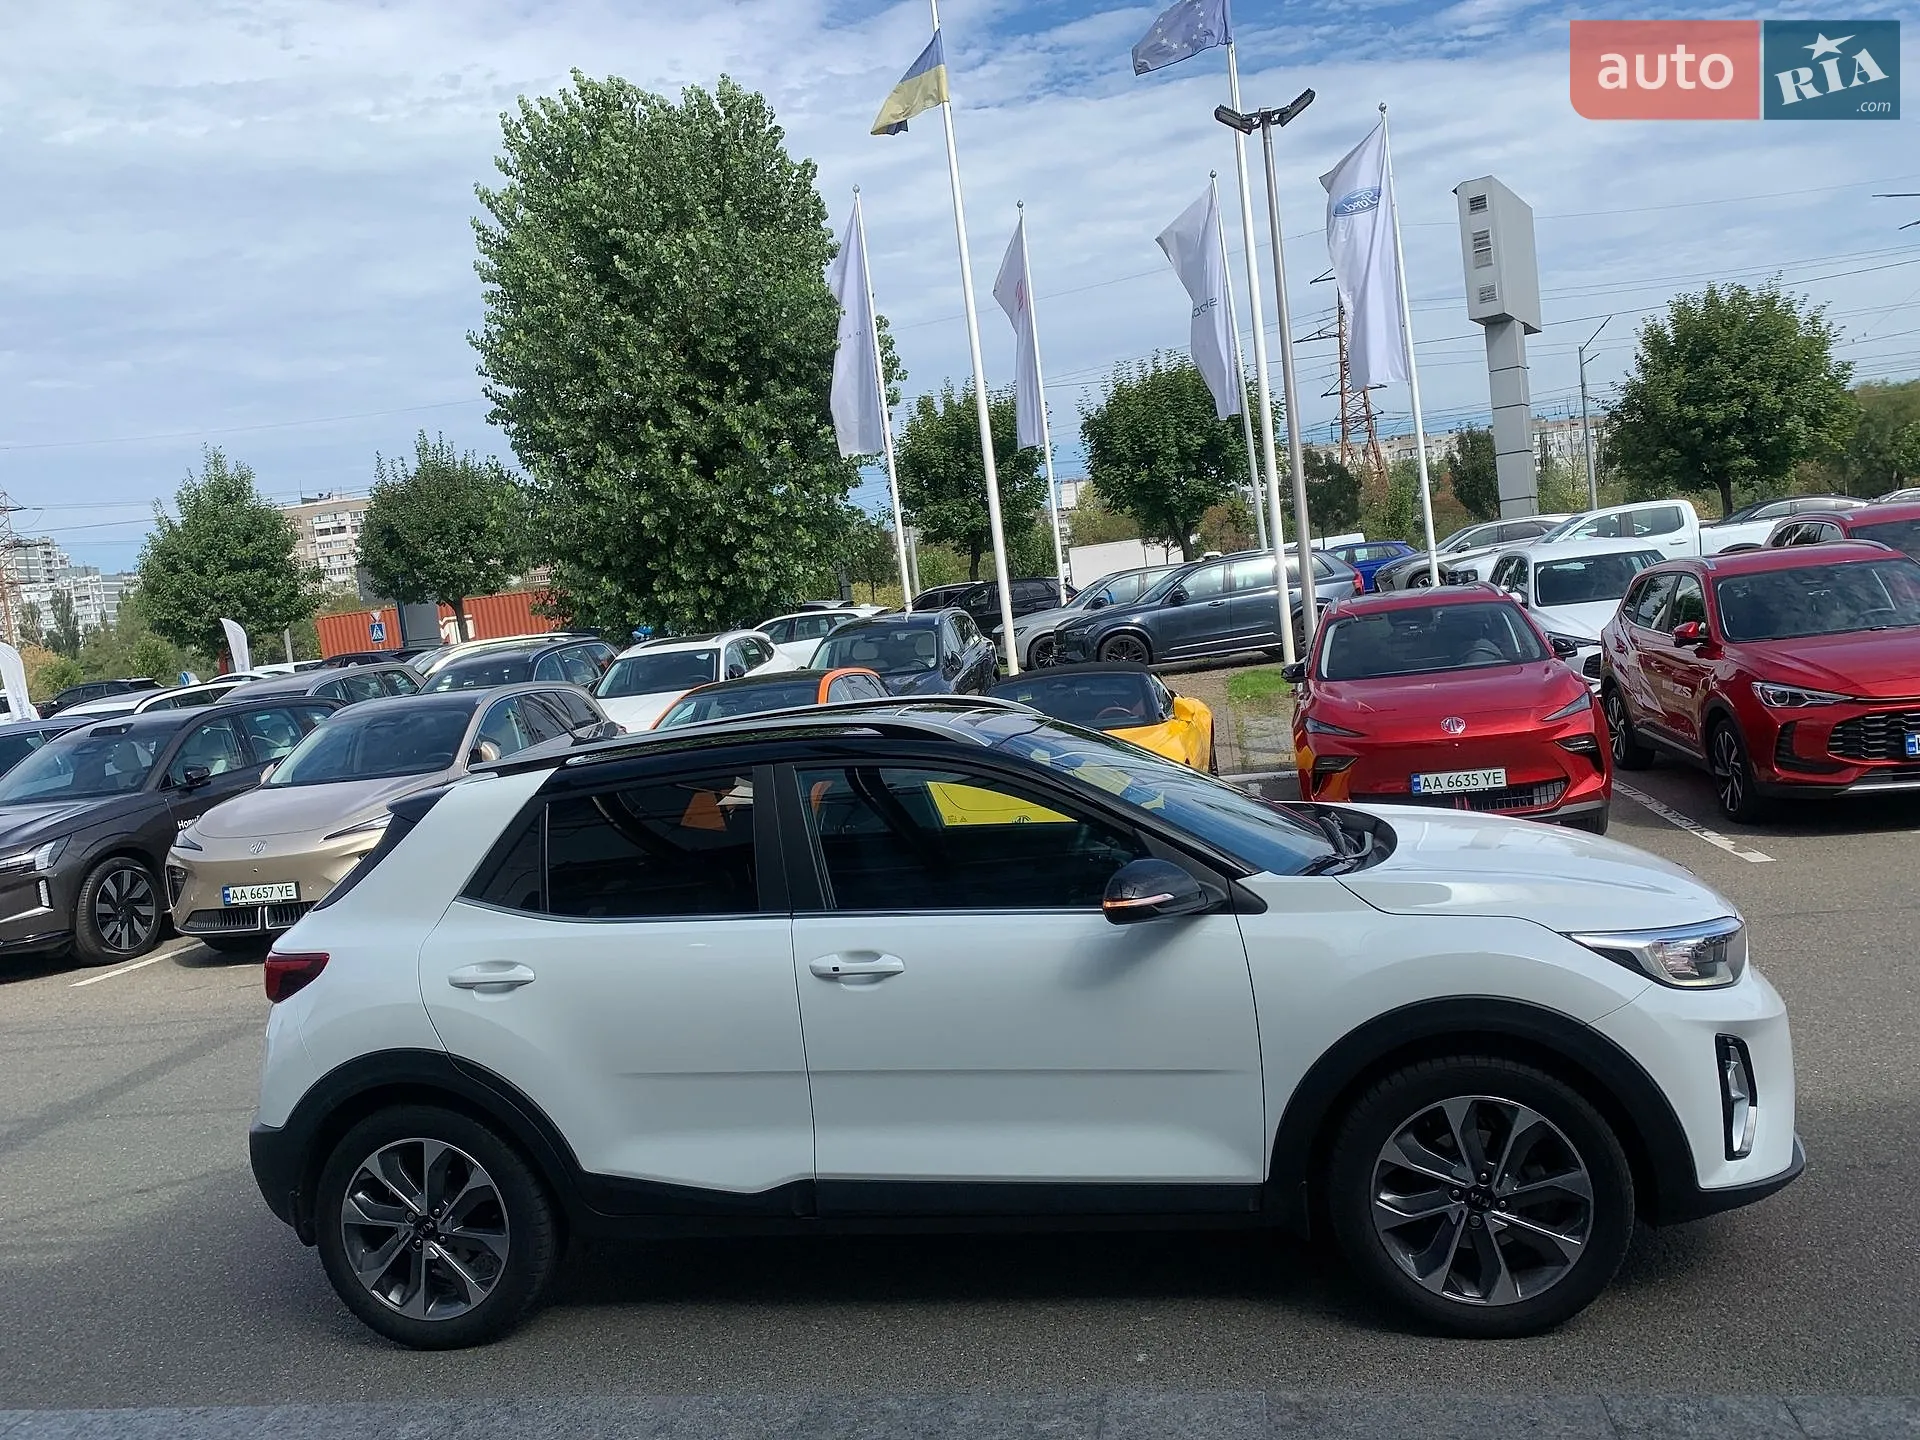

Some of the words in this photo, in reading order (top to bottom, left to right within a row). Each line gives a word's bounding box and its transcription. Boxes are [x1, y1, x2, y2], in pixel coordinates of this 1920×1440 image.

[1422, 776, 1443, 790] AA
[1447, 773, 1479, 788] 6635
[1482, 771, 1503, 785] YE
[232, 889, 248, 901] AA
[250, 886, 274, 900] 6657
[277, 885, 294, 898] YE
